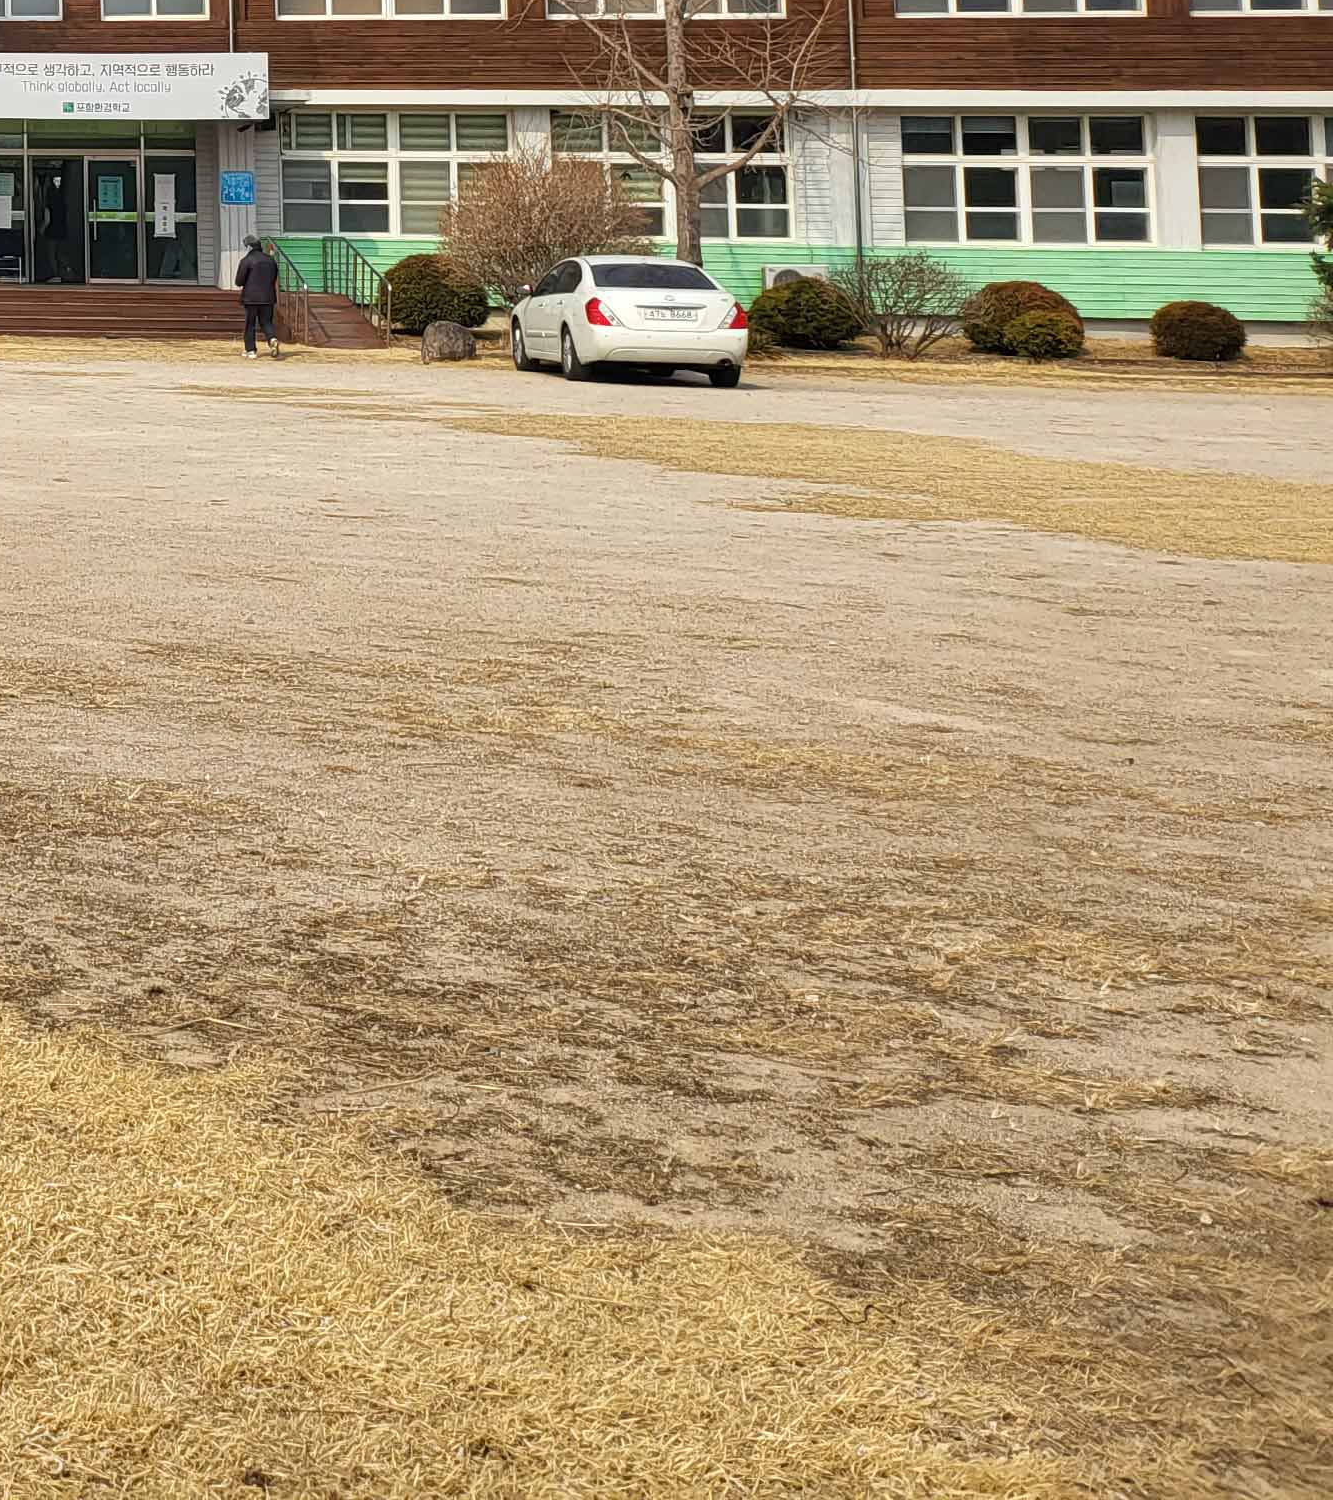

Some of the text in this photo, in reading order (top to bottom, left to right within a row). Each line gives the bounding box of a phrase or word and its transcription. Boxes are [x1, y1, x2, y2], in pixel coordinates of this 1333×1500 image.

[100, 63, 162, 77] 지역적으로
[165, 63, 215, 77] 행동하라
[21, 80, 53, 92] Think
[109, 80, 130, 93] Act
[133, 80, 172, 93] locally
